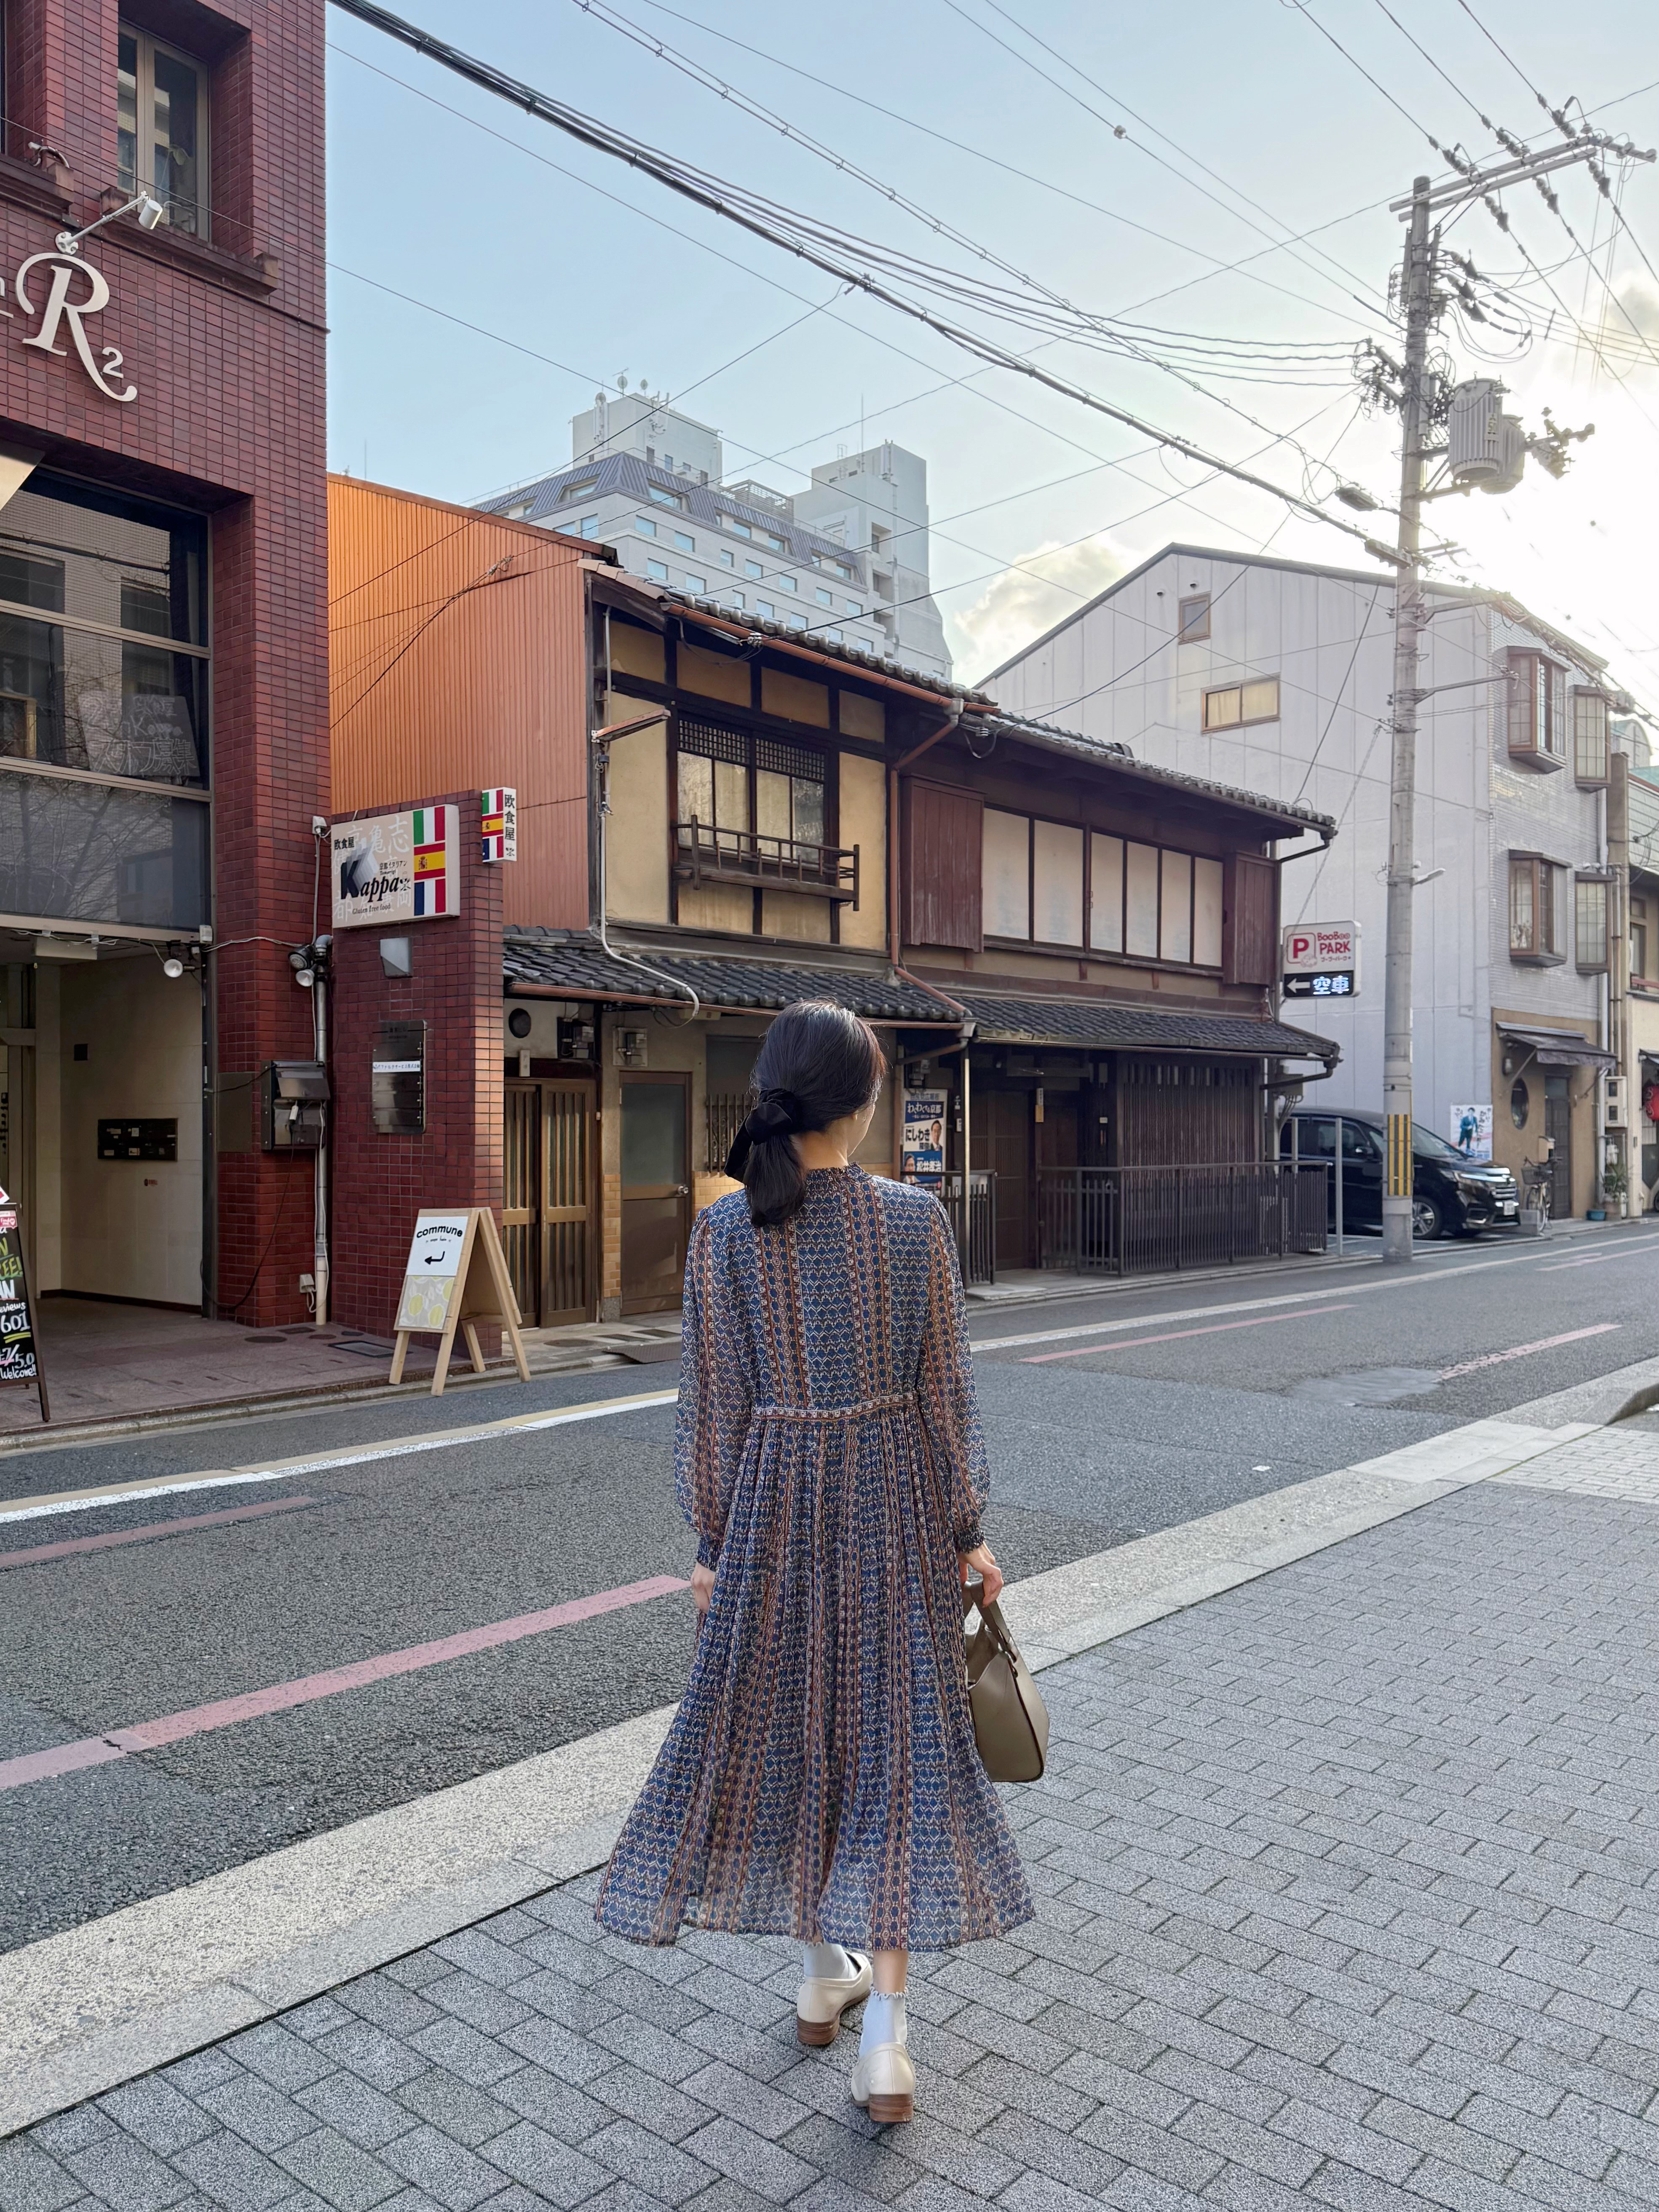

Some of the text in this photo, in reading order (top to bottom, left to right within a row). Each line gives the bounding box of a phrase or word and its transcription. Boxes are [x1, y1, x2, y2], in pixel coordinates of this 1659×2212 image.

[504, 794, 515, 841] 欧食屋
[334, 837, 354, 850] 欧食屋
[340, 859, 399, 903] Kappa
[1293, 938, 1309, 959] P
[1319, 941, 1351, 955] PARK
[1312, 975, 1350, 995] 空車
[905, 1128, 930, 1142] にしわき
[416, 1226, 463, 1238] commune
[0, 1302, 26, 1313] eviews
